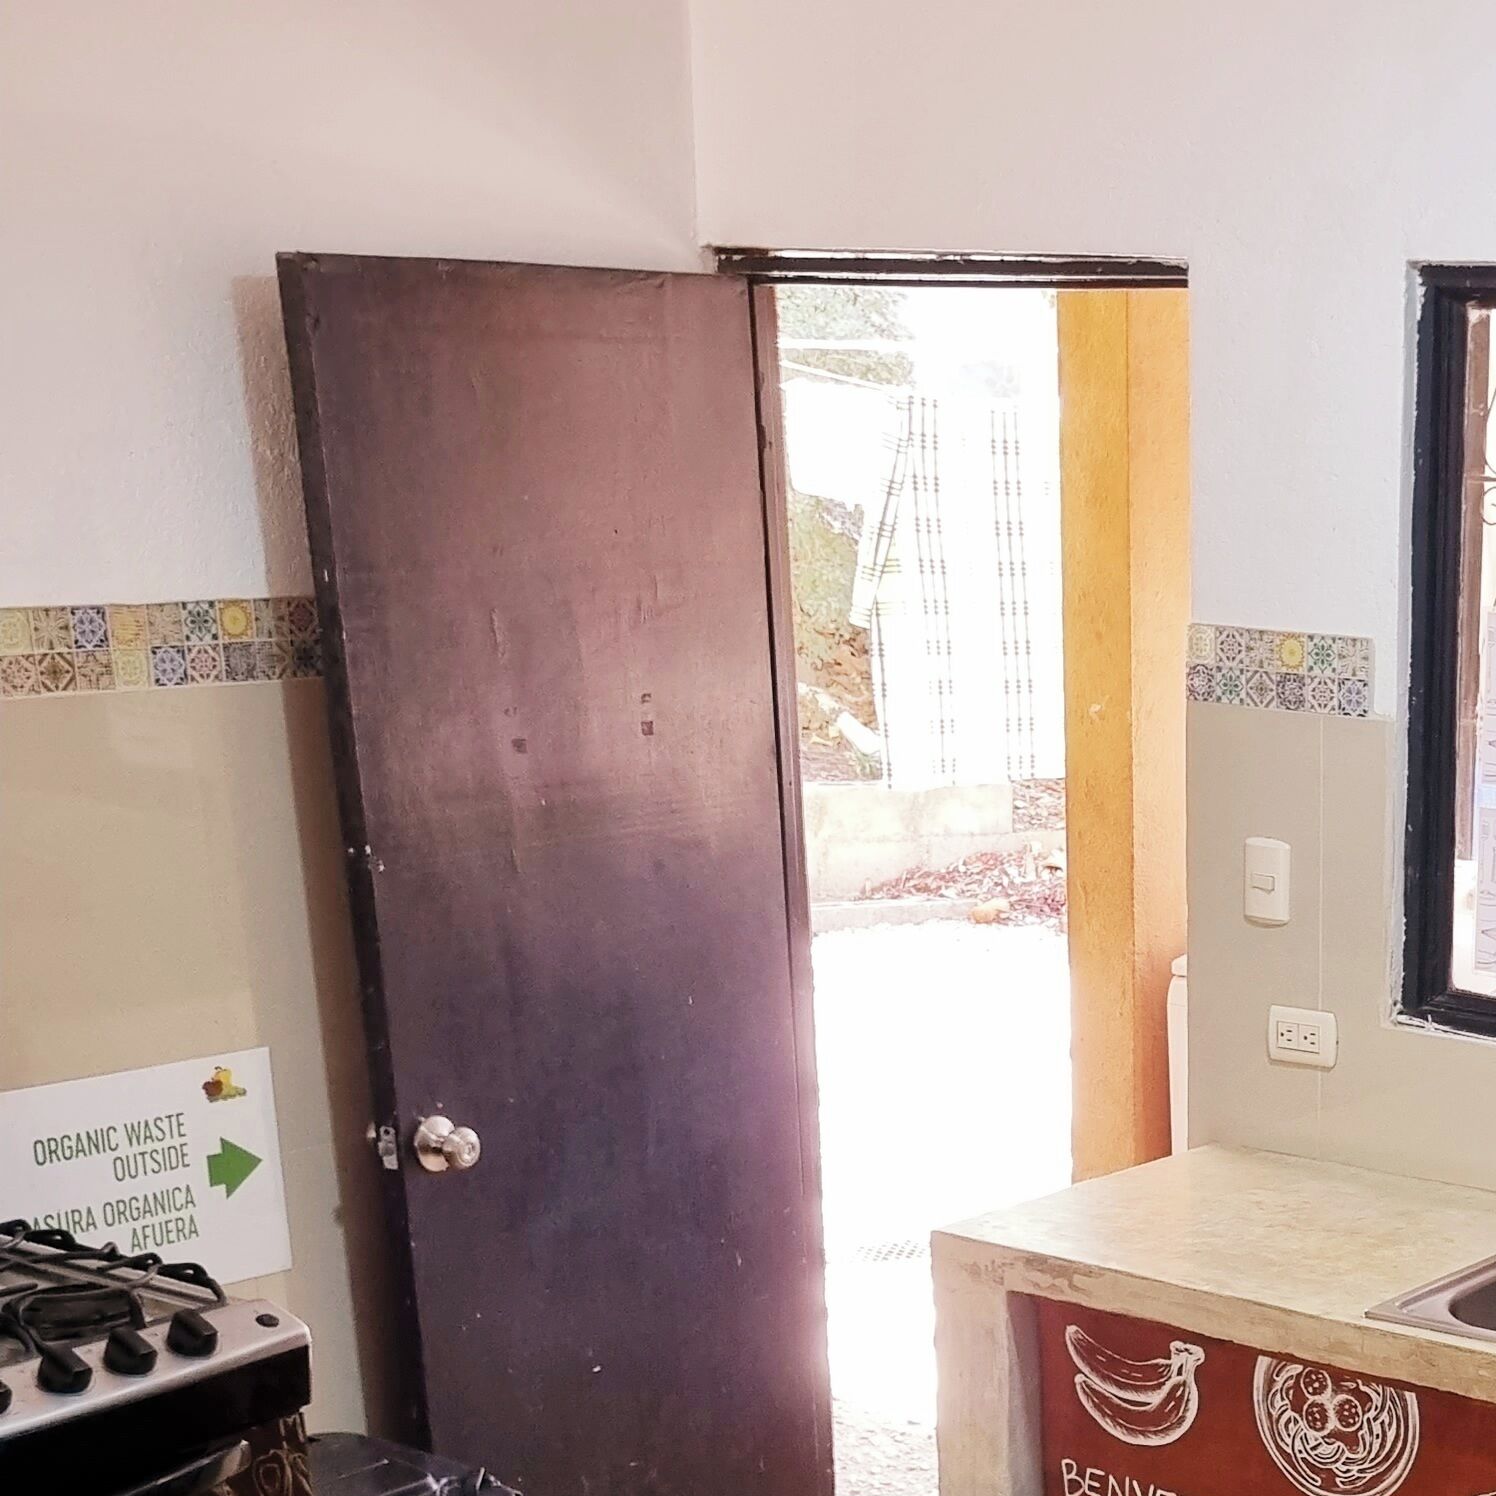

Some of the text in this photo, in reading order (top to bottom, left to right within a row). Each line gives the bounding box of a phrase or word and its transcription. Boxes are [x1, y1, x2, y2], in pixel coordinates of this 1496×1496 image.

[33, 1112, 187, 1167] ORGANIC WASTE
[113, 1143, 191, 1183] OUTSIDE
[32, 1184, 196, 1234] ASURA ORGANICA
[131, 1214, 200, 1252] AFUERA
